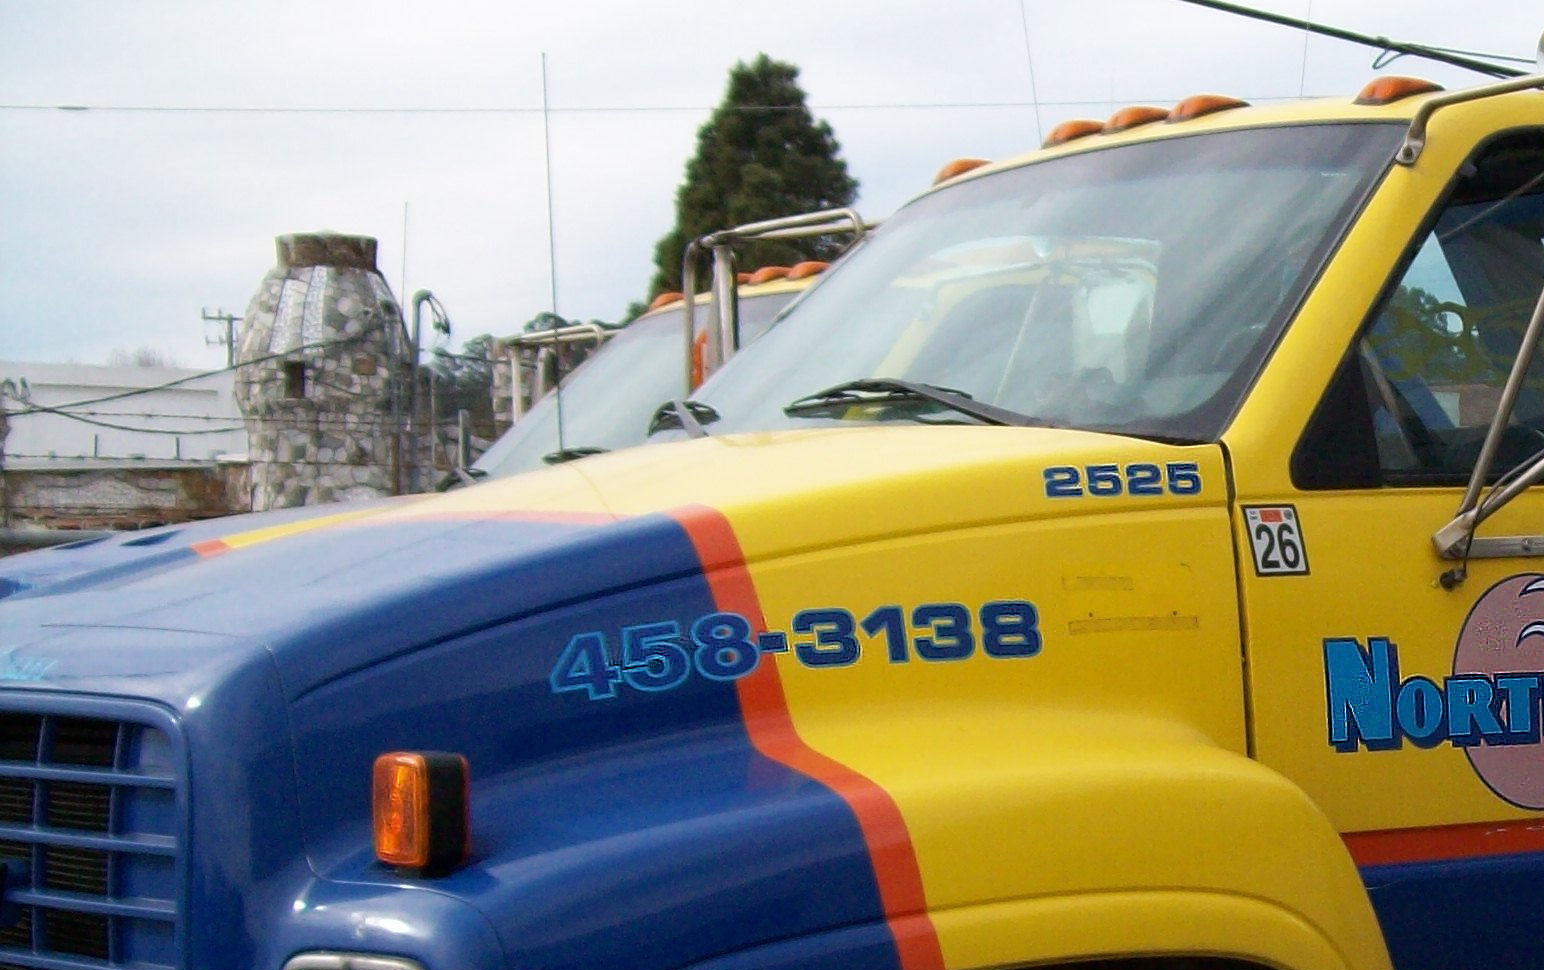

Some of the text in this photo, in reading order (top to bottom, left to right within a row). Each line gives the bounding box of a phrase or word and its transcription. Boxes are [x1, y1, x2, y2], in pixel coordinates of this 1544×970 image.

[1043, 462, 1203, 499] 2525
[1255, 523, 1300, 569] 26
[549, 598, 1043, 701] 458-3138
